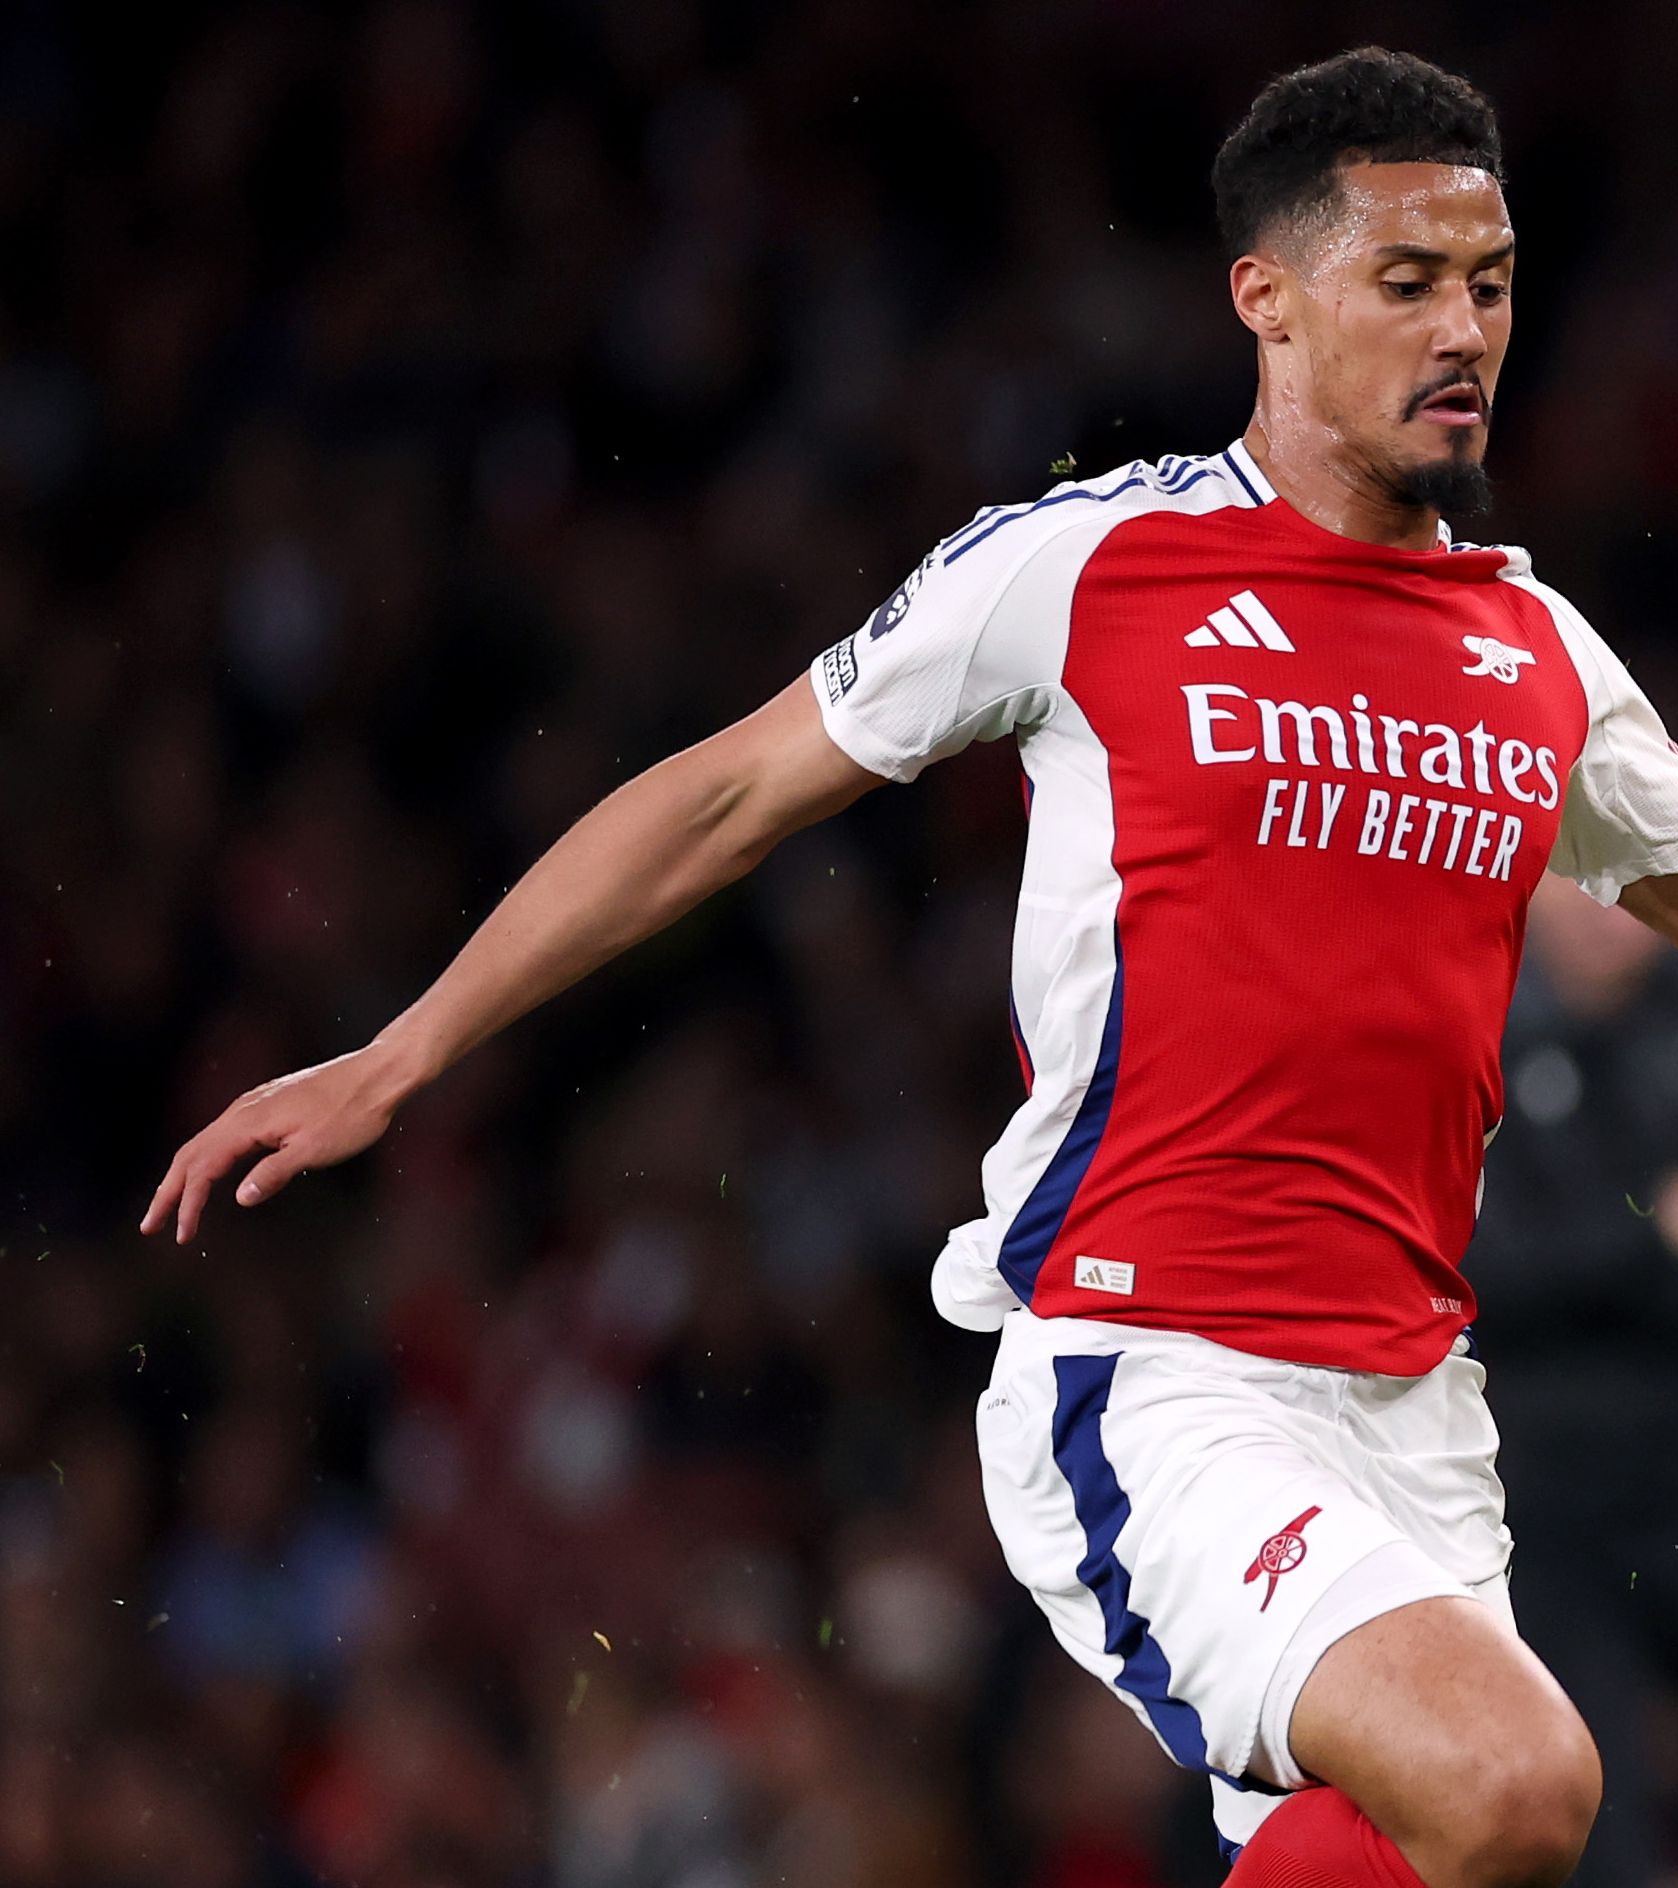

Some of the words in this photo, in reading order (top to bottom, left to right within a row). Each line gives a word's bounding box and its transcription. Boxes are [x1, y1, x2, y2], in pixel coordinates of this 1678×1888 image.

[1180, 684, 1558, 810] Emirates
[1257, 778, 1345, 849] FLY
[1358, 789, 1522, 881] BETTER
